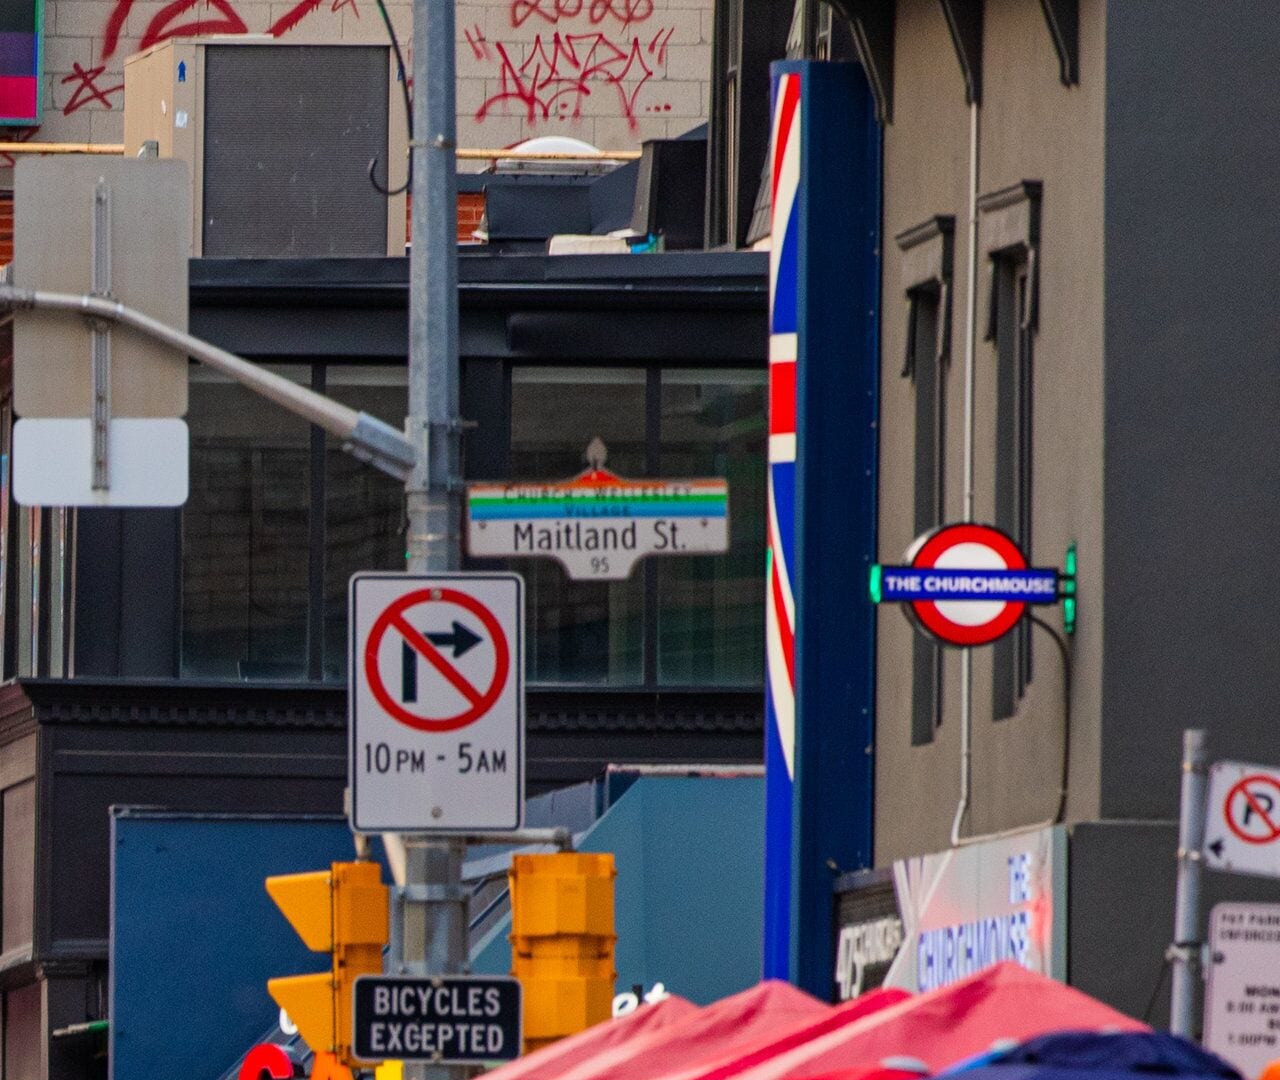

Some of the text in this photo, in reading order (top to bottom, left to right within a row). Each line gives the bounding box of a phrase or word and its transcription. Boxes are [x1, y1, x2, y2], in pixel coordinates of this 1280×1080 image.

[514, 521, 686, 550] Maitland St.
[591, 557, 610, 573] 95
[885, 576, 1055, 594] THE CHURCHMOUSE
[375, 986, 501, 1016] BICYCLES
[370, 1022, 504, 1053] EXCEPTED
